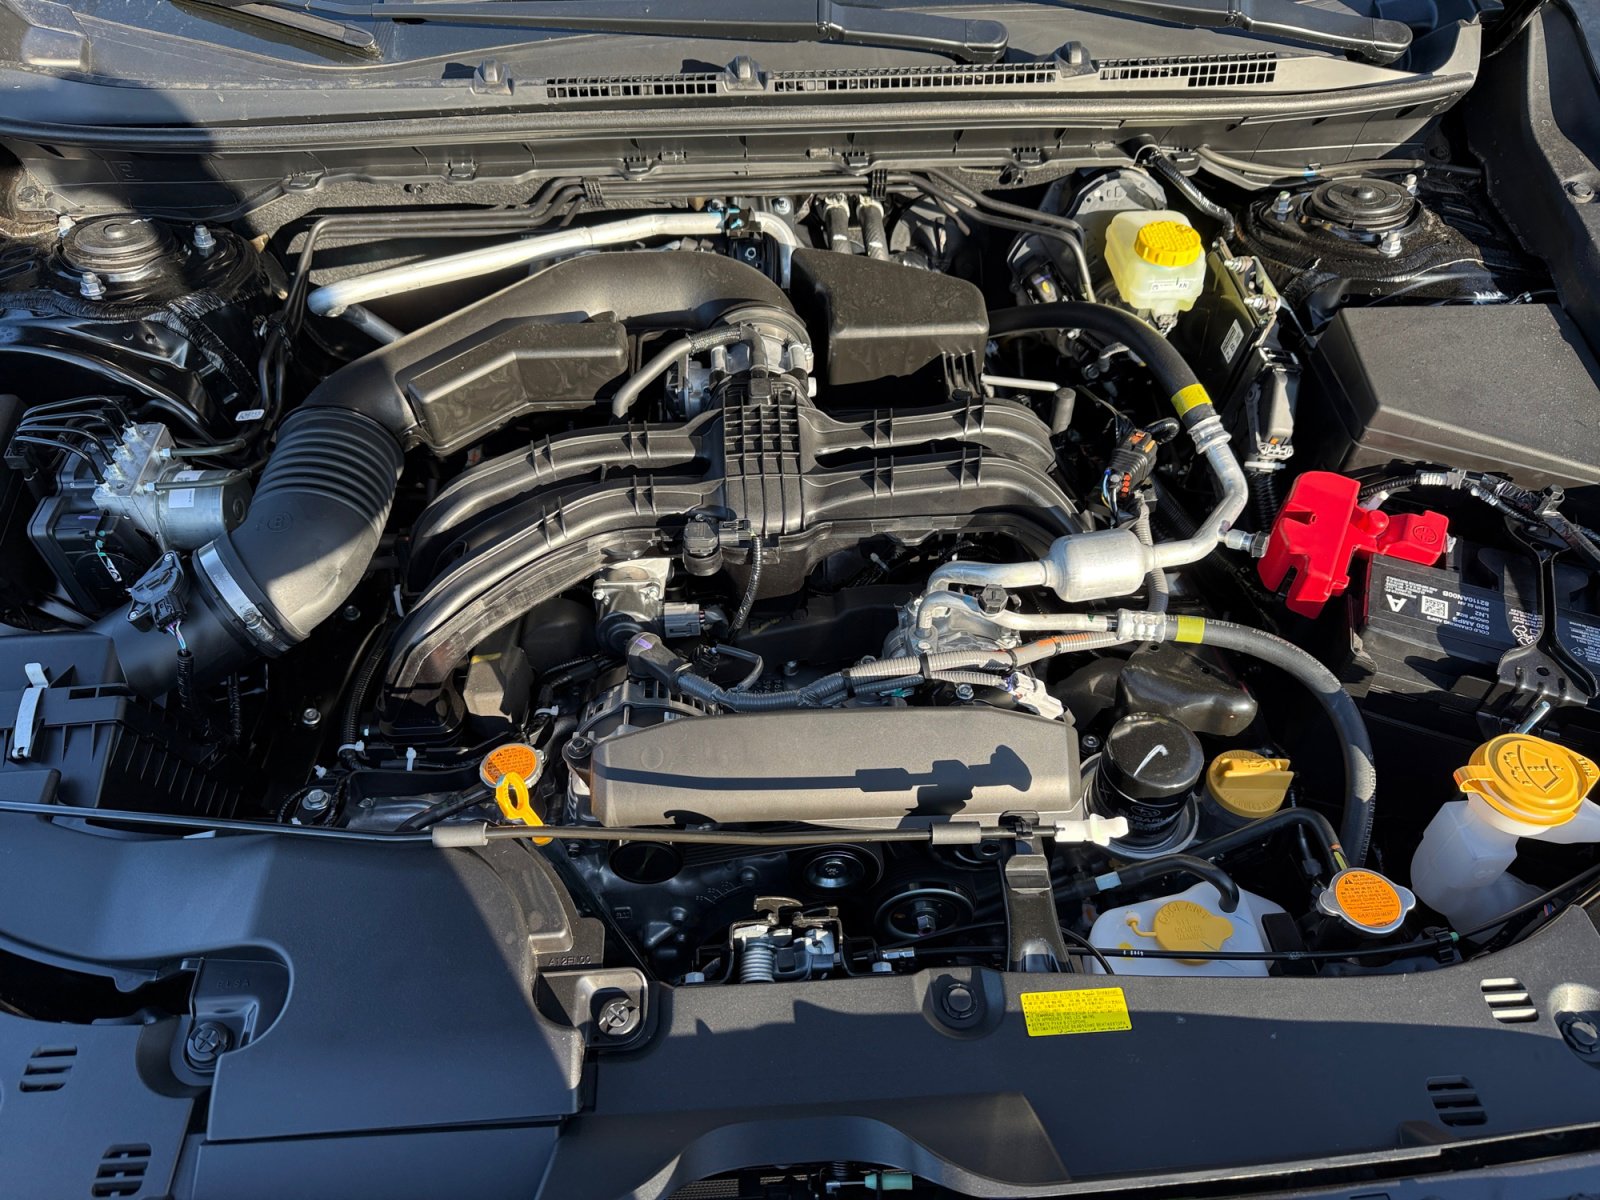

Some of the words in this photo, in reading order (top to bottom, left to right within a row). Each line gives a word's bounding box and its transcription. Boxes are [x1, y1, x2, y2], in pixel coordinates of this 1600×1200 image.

[1442, 590, 1490, 607] 82110AN00B
[1426, 615, 1443, 623] AMPS
[1474, 610, 1490, 618] LN2
[1443, 620, 1473, 630] CRANKING
[1452, 616, 1475, 626] AMPS
[1473, 628, 1490, 636] COLD
[1368, 765, 1377, 813] NICHIRIN
